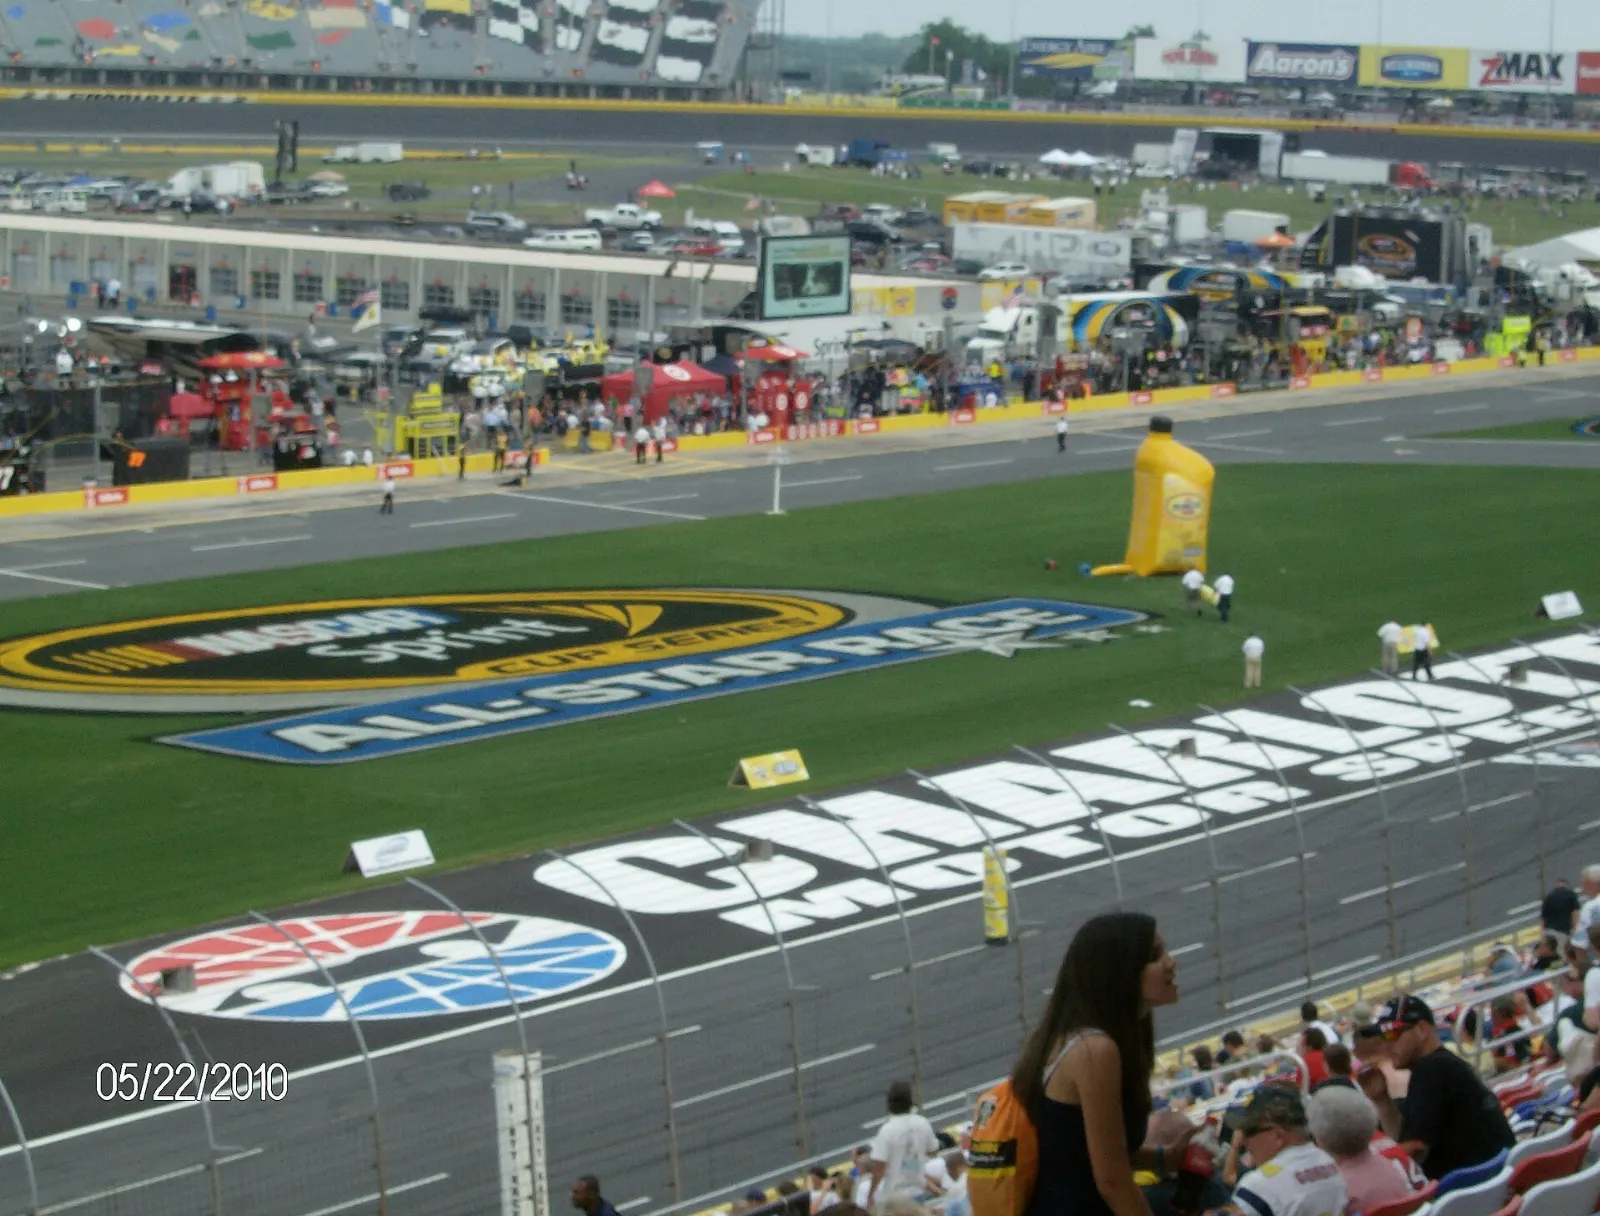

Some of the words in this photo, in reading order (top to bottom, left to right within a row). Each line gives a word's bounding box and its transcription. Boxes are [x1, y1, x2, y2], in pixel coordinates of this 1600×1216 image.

[1252, 47, 1350, 78] Aaron's
[173, 607, 450, 657] NASCAR
[306, 617, 591, 664] Sprint
[487, 649, 611, 675] CUP
[624, 616, 818, 652] SERIES
[271, 649, 839, 754] ALL-STAR
[803, 606, 1087, 658] RACE
[718, 779, 1311, 935] MOTOR
